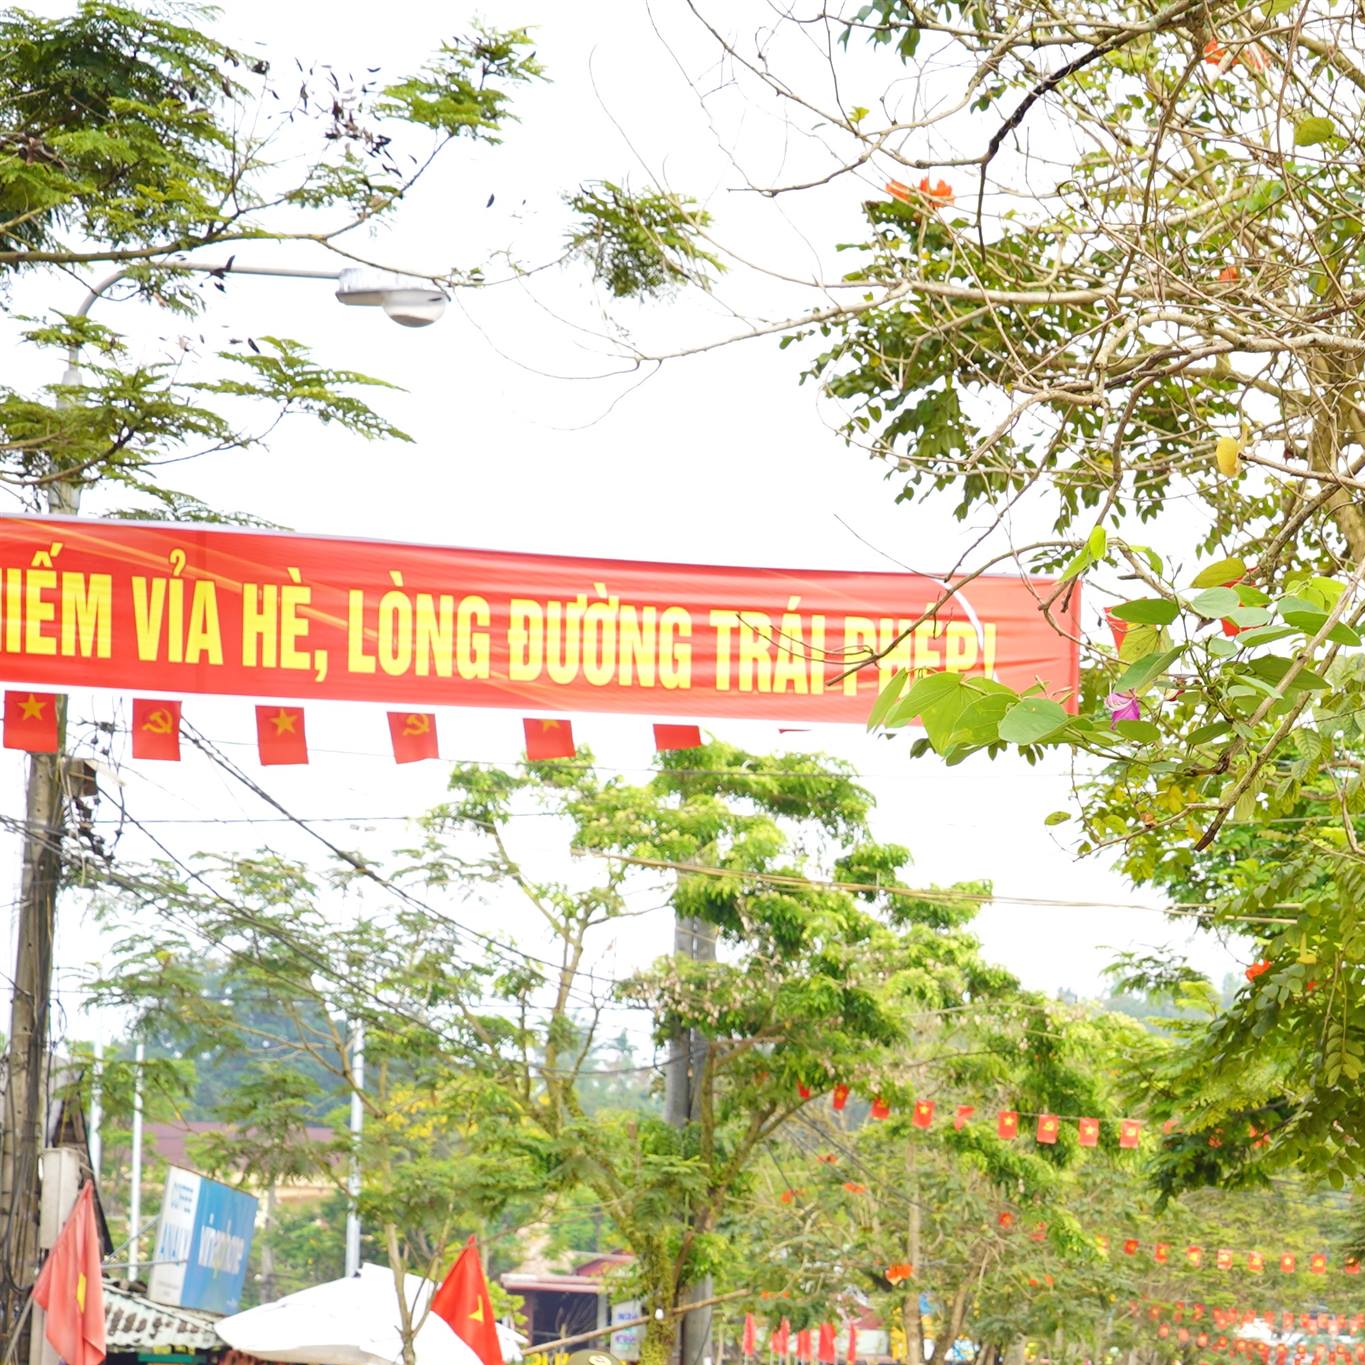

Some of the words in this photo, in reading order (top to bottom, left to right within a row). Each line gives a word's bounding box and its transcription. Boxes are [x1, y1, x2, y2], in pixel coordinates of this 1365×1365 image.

[131, 548, 224, 665] VỈA
[242, 567, 328, 682] HÈ,
[348, 570, 491, 680] LÒNG
[508, 582, 692, 690] ĐƯỜNG
[710, 596, 826, 696] TRÁI
[843, 603, 997, 697] PHÉP!
